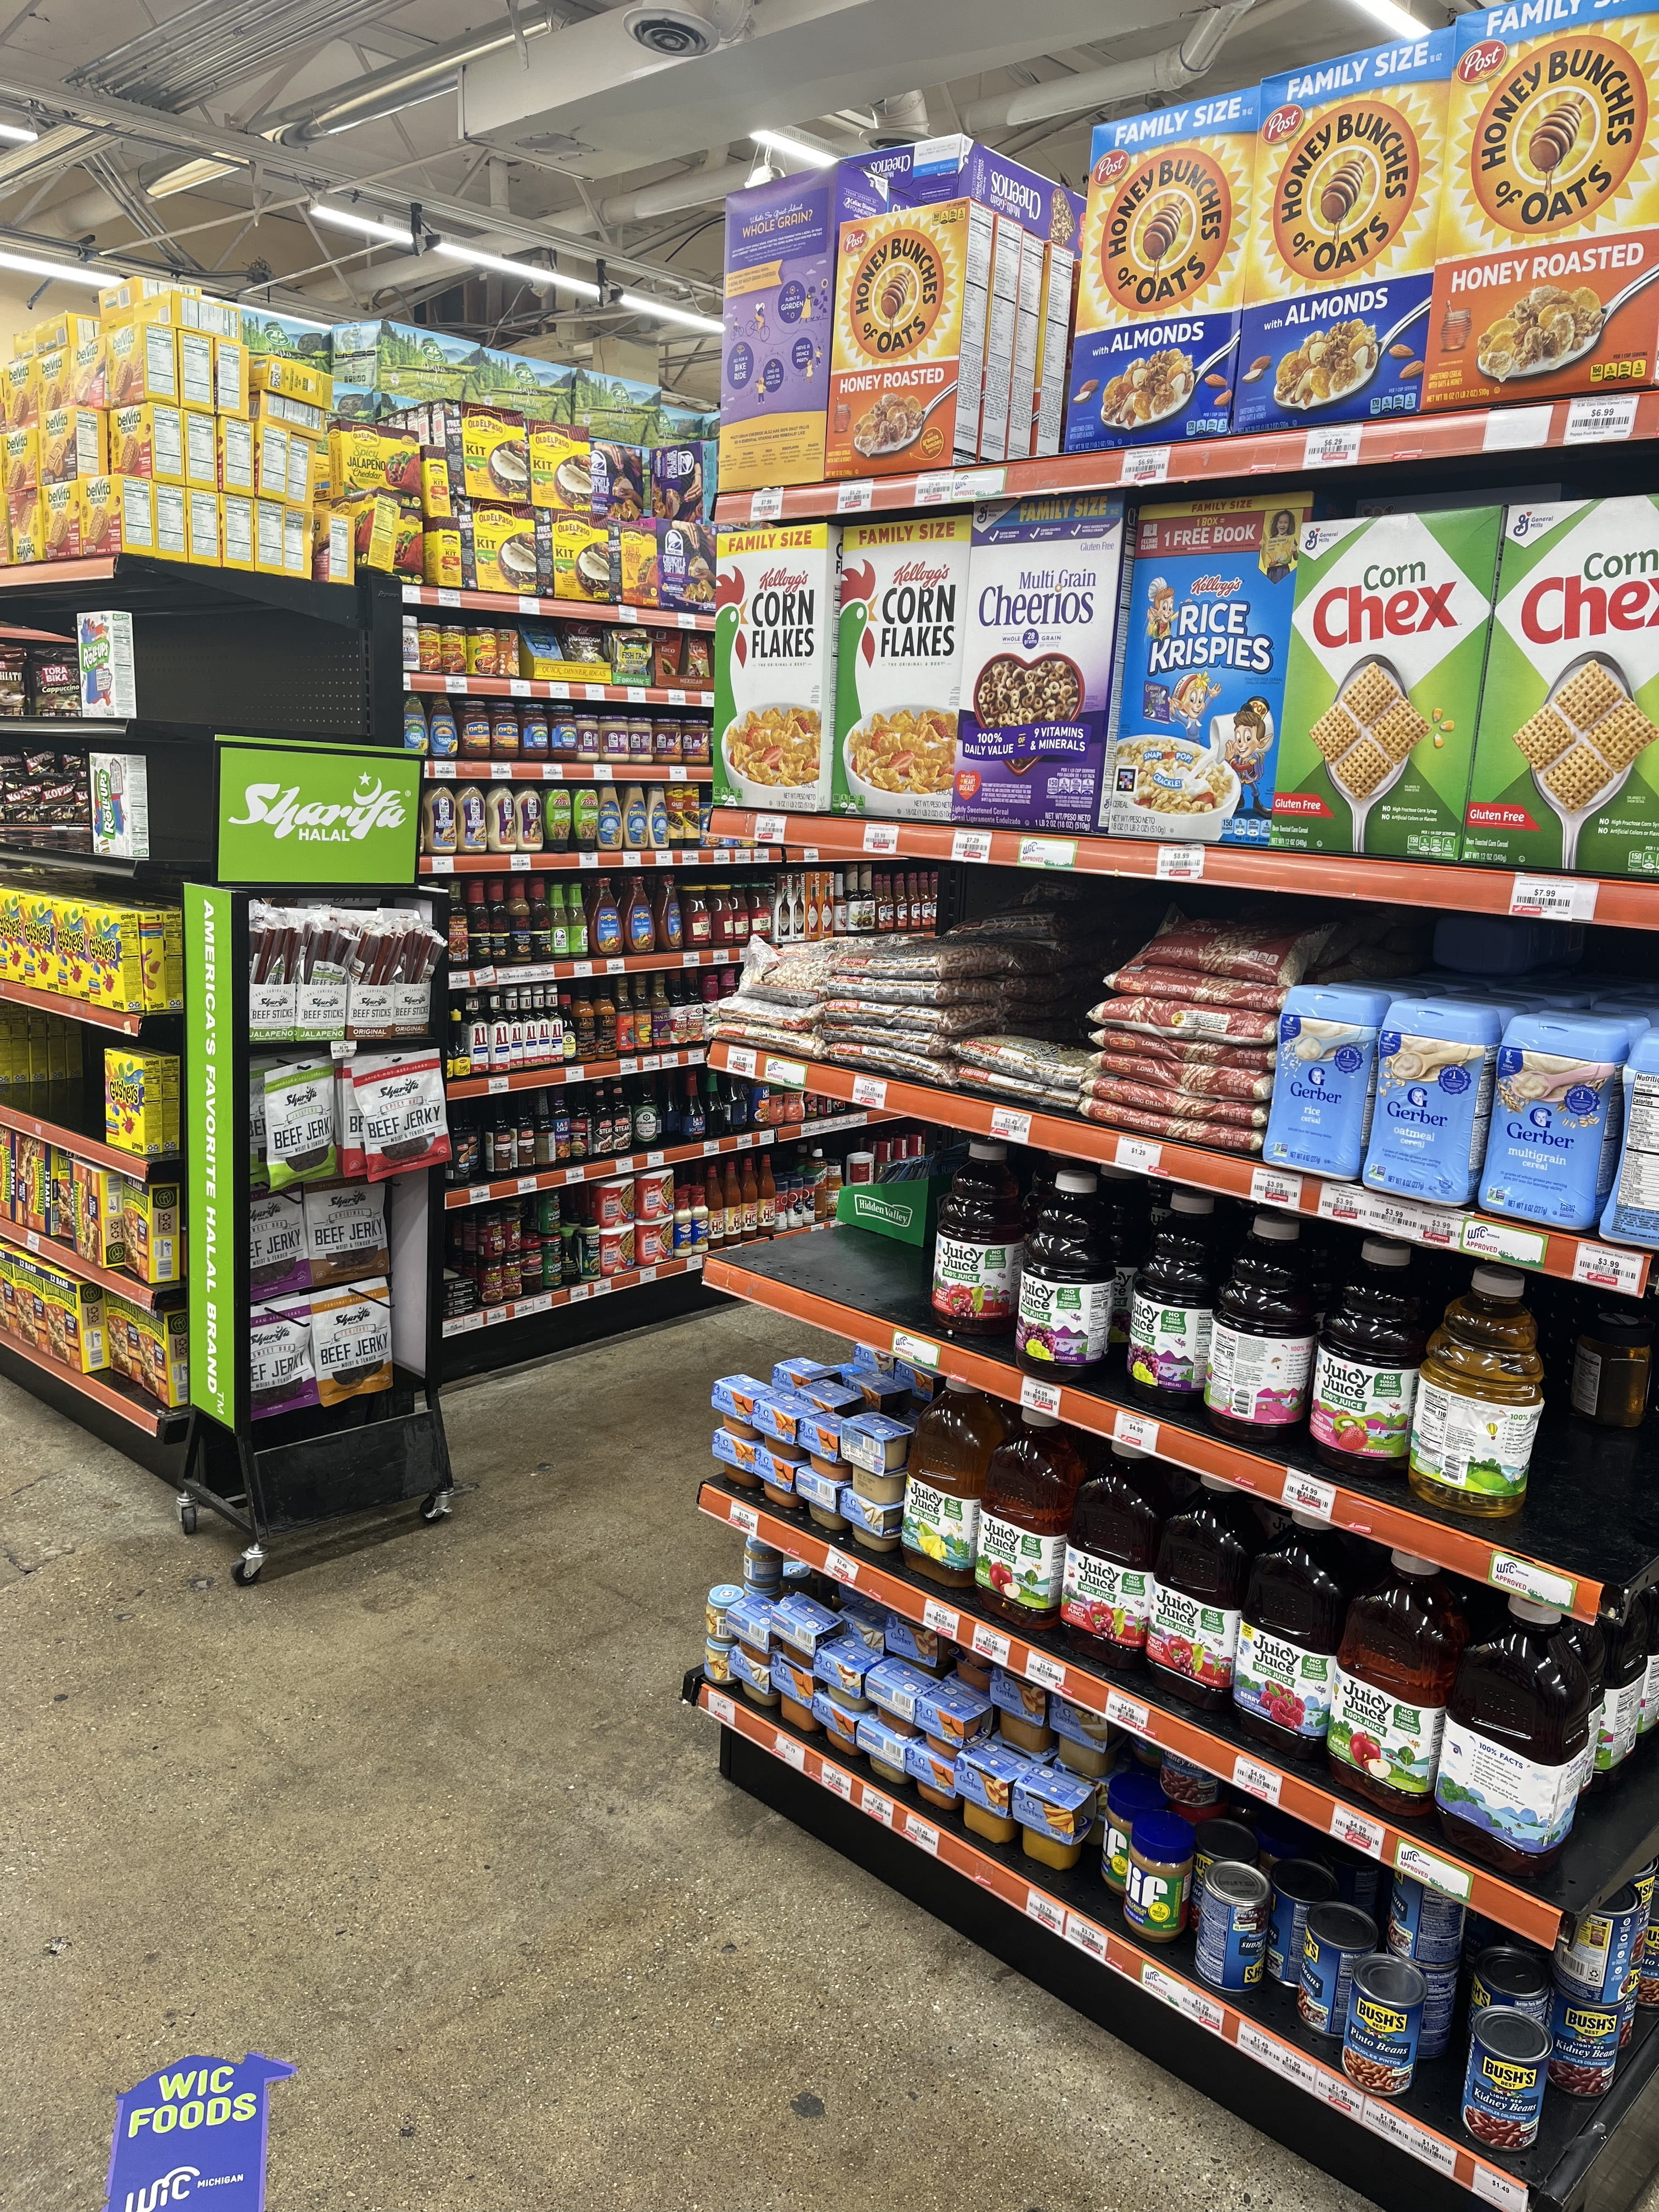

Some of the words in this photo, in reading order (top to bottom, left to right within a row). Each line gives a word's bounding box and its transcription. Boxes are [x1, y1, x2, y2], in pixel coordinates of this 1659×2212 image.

[1287, 58, 1368, 101] FAMILY
[1374, 42, 1428, 77] SIZE
[1464, 48, 1502, 76] Post
[1114, 110, 1189, 146] FAMILY
[1194, 97, 1242, 122] SIZE
[1481, 60, 1541, 171] HONEY
[1549, 48, 1634, 146] BUNCHES
[1267, 111, 1298, 135] Post
[1098, 157, 1125, 177] Post
[1281, 124, 1330, 223] HONEY
[1337, 112, 1408, 199] BUNCHES
[1521, 165, 1612, 225] OATS
[1109, 167, 1153, 259] HONEY
[1160, 159, 1222, 240] BUNCHES
[742, 217, 776, 239] WHOLE
[777, 210, 813, 230] GRAIN?
[845, 233, 866, 250] Post
[1314, 215, 1390, 272] OATS
[856, 246, 888, 315] HONEY
[891, 238, 938, 304] BUNCHES
[1136, 255, 1205, 304] OATS
[1451, 257, 1533, 294] HONEY
[1536, 244, 1644, 278] ROASTED
[781, 301, 804, 312] GARDEN
[1285, 287, 1389, 326] ALMONDS
[877, 315, 926, 352] OATS
[1092, 344, 1109, 357] with
[1111, 321, 1204, 352] ALMONDS
[839, 374, 881, 394] HONEY
[884, 368, 944, 388] ROASTED
[117, 409, 142, 429] belVita
[347, 456, 386, 470] JALAPEÑO
[466, 445, 486, 456] KIT
[352, 468, 382, 482] Cheddar
[1019, 501, 1071, 522] FAMILY
[1075, 496, 1107, 516] SIZE
[1192, 502, 1225, 513] FAMILY
[729, 533, 777, 552] FAMILY
[780, 531, 812, 547] SIZE
[1164, 534, 1171, 545] 1
[1173, 531, 1209, 545] FREE
[1212, 526, 1255, 543] BOOK
[759, 568, 809, 592] Kellogg's
[1019, 571, 1054, 590] Multi
[1058, 569, 1096, 588] Grain
[1190, 574, 1242, 596] Kellogg's
[1363, 562, 1426, 591] Corn
[752, 589, 815, 627] CORN
[882, 585, 956, 624] CORN
[979, 586, 1094, 626] Cheerios
[1313, 582, 1457, 648] Chex
[1179, 602, 1249, 635] RICE
[752, 628, 814, 658] FLAKES
[881, 625, 955, 658] FLAKES
[1149, 637, 1271, 674] KRISPIES
[977, 732, 1003, 744] 100%
[1041, 726, 1084, 738] VITAMINS
[1039, 740, 1086, 752] MINERALS
[1176, 752, 1192, 763] POP!
[1154, 774, 1182, 788] CRACKLE!
[229, 777, 407, 839] Sharifa
[1274, 799, 1301, 810] Gluten
[298, 828, 350, 842] HALAL
[203, 899, 217, 1056] AMERICA'S
[474, 1028, 487, 1045] A1
[109, 1080, 139, 1104] Gushers
[1290, 1082, 1341, 1104] Gerber
[368, 1118, 402, 1138] BEEF
[404, 1106, 440, 1130] JERKY
[1304, 1106, 1321, 1117] rice
[1387, 1102, 1447, 1127] Gerber
[205, 1064, 218, 1199] FAVORITE
[1393, 1126, 1435, 1142] oatmeal
[1400, 1137, 1425, 1148] cereal
[1506, 1122, 1574, 1148] Gerber
[1508, 1146, 1566, 1167] multigrain
[1522, 1160, 1548, 1171] cereal
[860, 1200, 882, 1214] Hidden
[206, 1206, 217, 1294] HALAL
[943, 1242, 984, 1263] Juicy
[1466, 1241, 1497, 1253] APPROVED
[944, 1257, 979, 1273] Juice
[1323, 1358, 1373, 1387] Juicy
[1324, 1378, 1365, 1398] Juice
[1300, 1484, 1318, 1496] $4.99
[985, 1519, 1020, 1544] Juicy
[985, 1534, 1015, 1552] Juice
[1240, 1691, 1260, 1705] BERRY
[1344, 1680, 1392, 1713] Juicy
[1345, 1698, 1386, 1724] Juice
[1331, 1736, 1349, 1751] APPLE
[1479, 1742, 1497, 1754] 100%
[1499, 1750, 1523, 1769] FACTS
[1358, 2001, 1406, 2029] BUSH'S
[1350, 2028, 1374, 2049] Pinto
[1376, 2042, 1408, 2055] Beans
[159, 2066, 234, 2101] WIC
[1485, 2059, 1534, 2087] BUSH'S
[1474, 2089, 1506, 2111] Kidney
[1509, 2100, 1536, 2112] Beans
[128, 2093, 257, 2138] FOODS
[198, 2174, 244, 2188] MICHIGAN
[1492, 2180, 1510, 2193] $1.49
